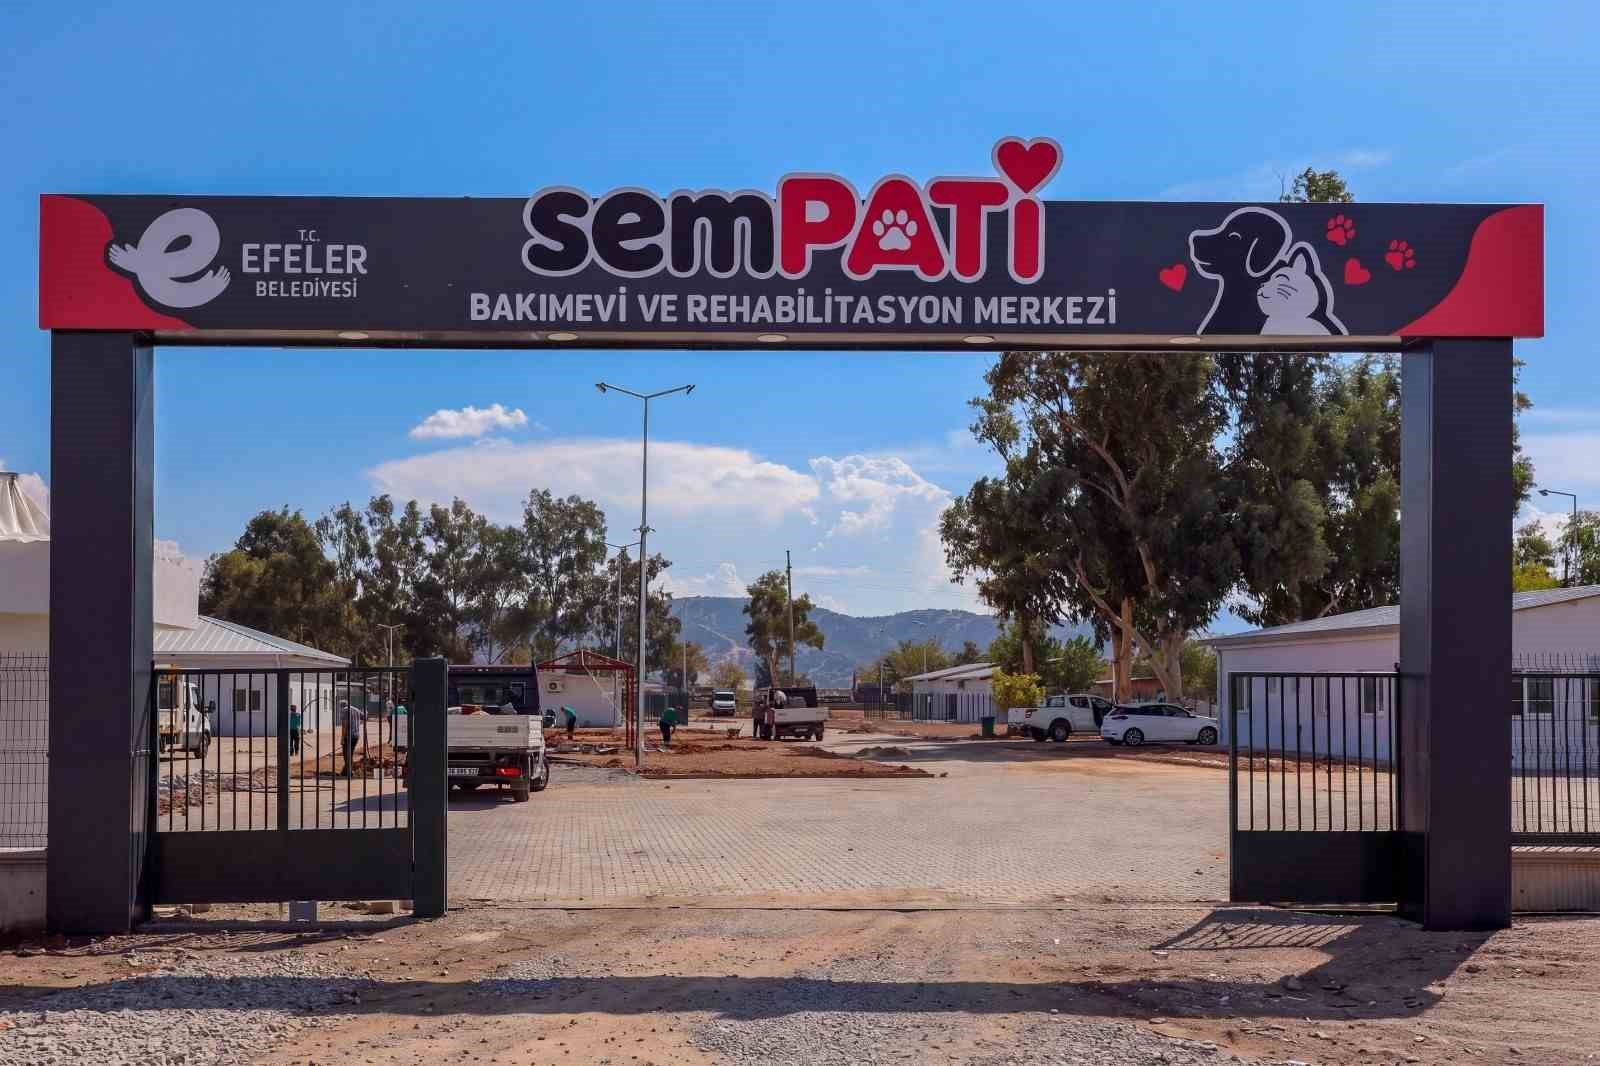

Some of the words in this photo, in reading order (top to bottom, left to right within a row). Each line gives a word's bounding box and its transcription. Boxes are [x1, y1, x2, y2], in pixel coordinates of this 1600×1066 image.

[298, 229, 321, 242] T.C.
[241, 243, 368, 275] EFELER
[255, 277, 358, 299] BELEDİYESİ
[469, 286, 627, 323] BAKIMEVİ
[637, 293, 678, 323] VE
[686, 287, 963, 325] REHABİLİTASYON
[973, 288, 1117, 326] MERKEZİ
